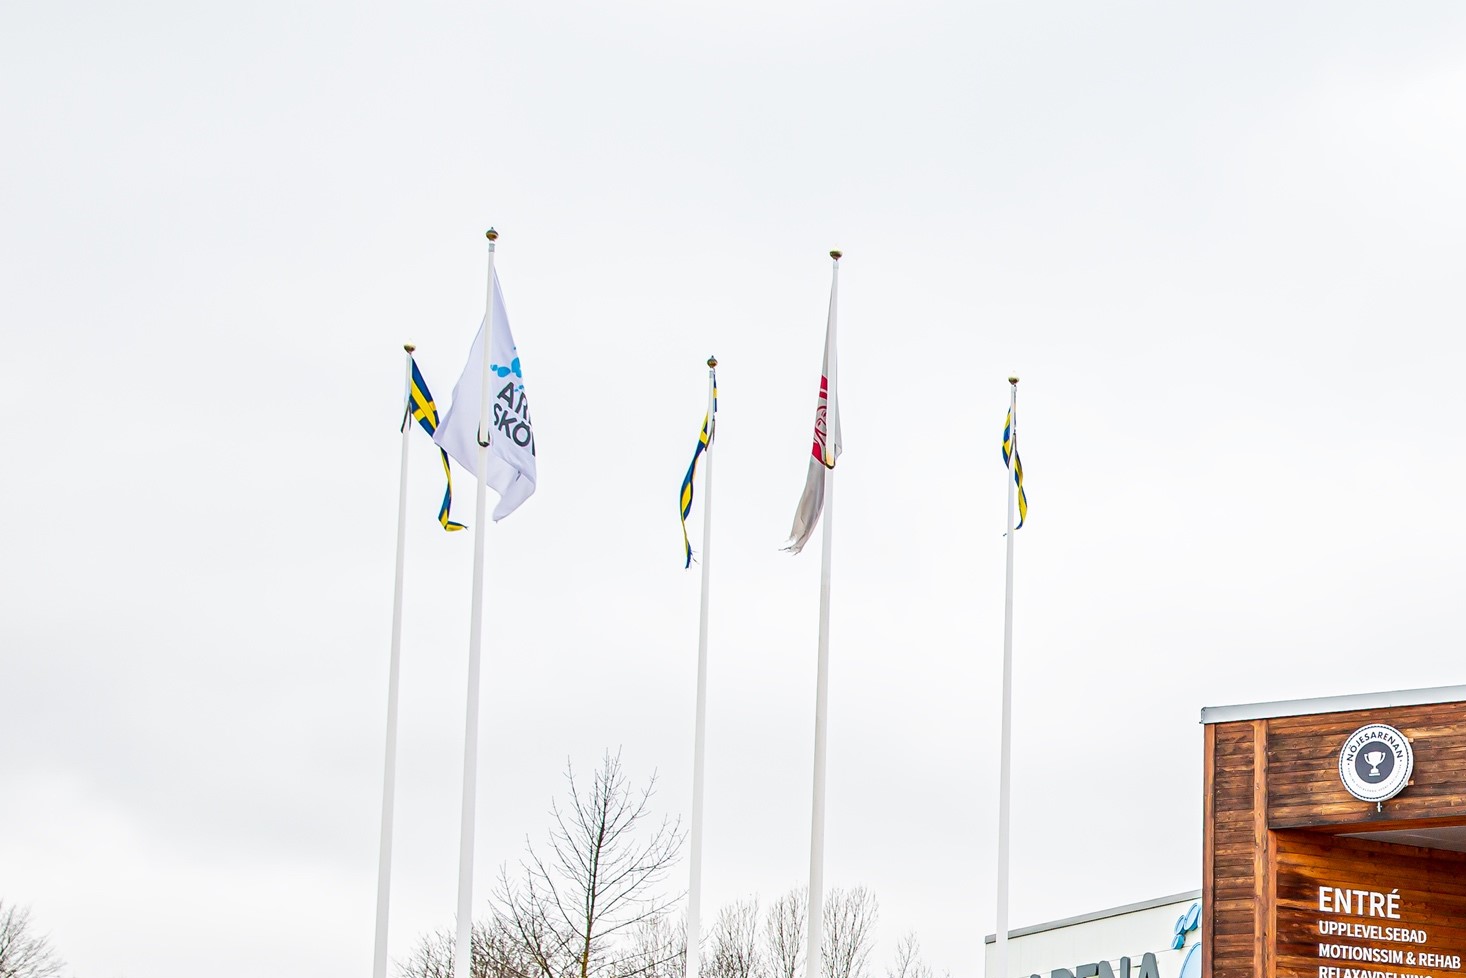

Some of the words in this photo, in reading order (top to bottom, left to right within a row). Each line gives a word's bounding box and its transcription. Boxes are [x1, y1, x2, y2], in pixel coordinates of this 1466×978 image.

[497, 381, 531, 426] AR
[494, 403, 535, 457] SKÖ
[1346, 731, 1404, 762] NÖJESARENAN
[1319, 886, 1401, 919] ENTRÉ
[1319, 920, 1427, 944] UPPLEVELSEBAD
[1318, 943, 1403, 965] MOTIONSSIM
[1405, 951, 1416, 966] &
[1418, 952, 1461, 969] REHAB
